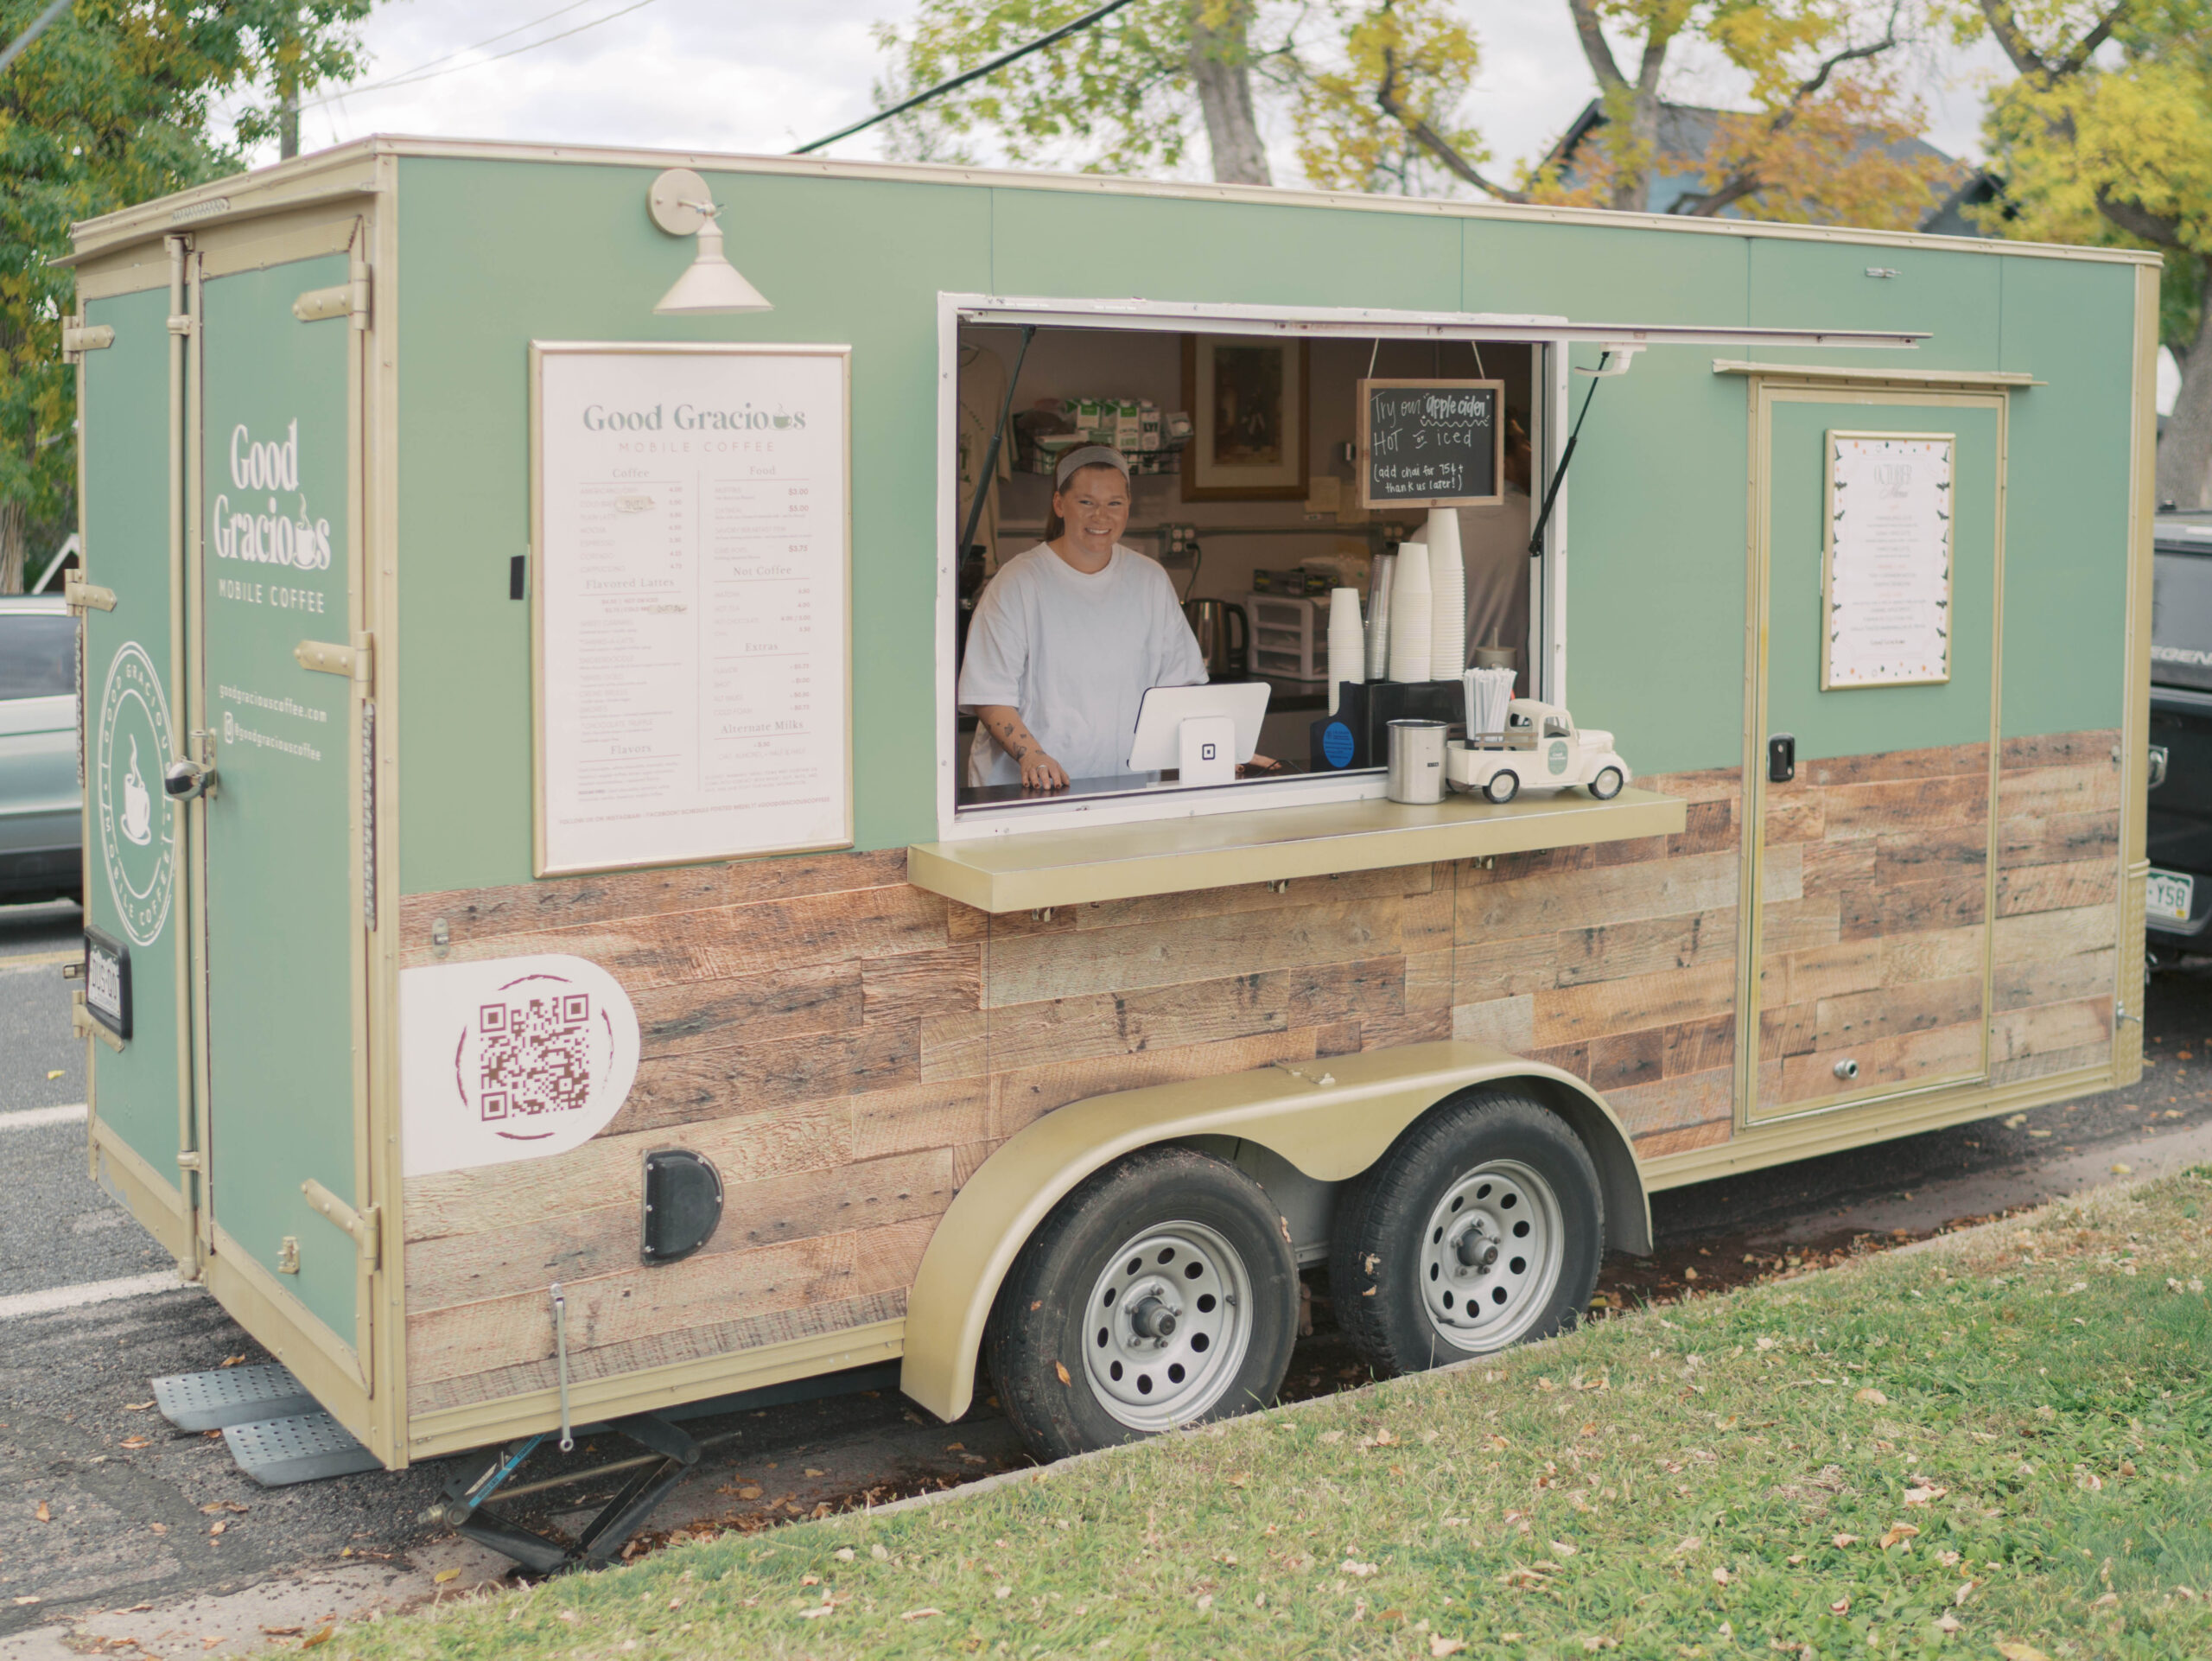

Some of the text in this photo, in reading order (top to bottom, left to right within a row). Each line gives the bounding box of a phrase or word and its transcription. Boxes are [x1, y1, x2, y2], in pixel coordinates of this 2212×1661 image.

[1370, 391, 1396, 428] Try
[583, 404, 663, 431] Good
[1437, 430, 1472, 448] iced
[231, 417, 299, 491] Good
[619, 442, 774, 453] MOBILE COFFEE
[612, 468, 650, 478] Coffee
[749, 465, 776, 476] Food
[1402, 464, 1420, 479] chai
[1423, 465, 1434, 476] for
[1385, 481, 1414, 493] thank
[733, 565, 792, 576] Not Coffee
[585, 577, 676, 589] Flavored Lattes
[219, 578, 325, 614] MOBILE COFFEE
[745, 642, 779, 652] Extras
[219, 684, 327, 722] goodgraciouscoffee.com
[721, 719, 804, 735] Alternate Milks
[610, 744, 652, 754] Flavors
